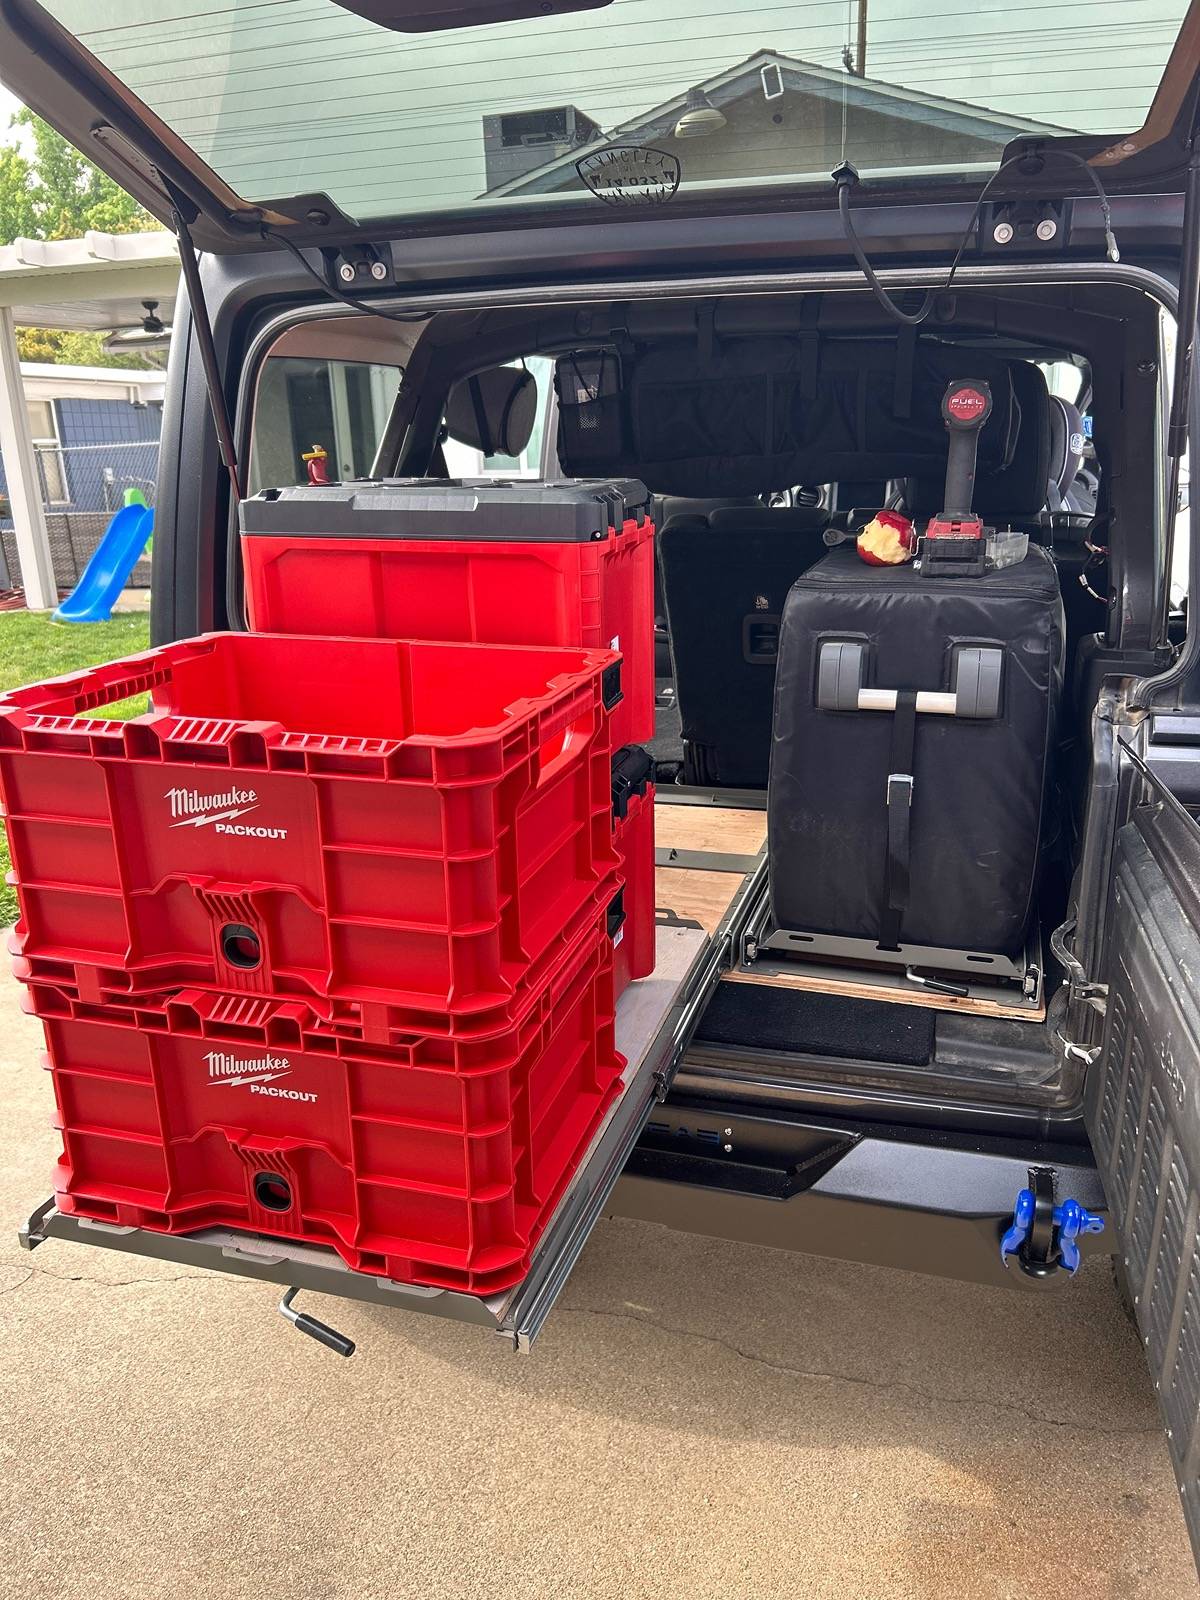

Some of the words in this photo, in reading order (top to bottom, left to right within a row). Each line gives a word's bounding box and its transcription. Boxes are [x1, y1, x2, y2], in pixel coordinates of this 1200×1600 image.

[163, 785, 258, 818] Milwaukee
[215, 823, 288, 840] PACKOUT
[202, 1051, 291, 1078] Milwaukee
[250, 1084, 318, 1103] PACKOUT
